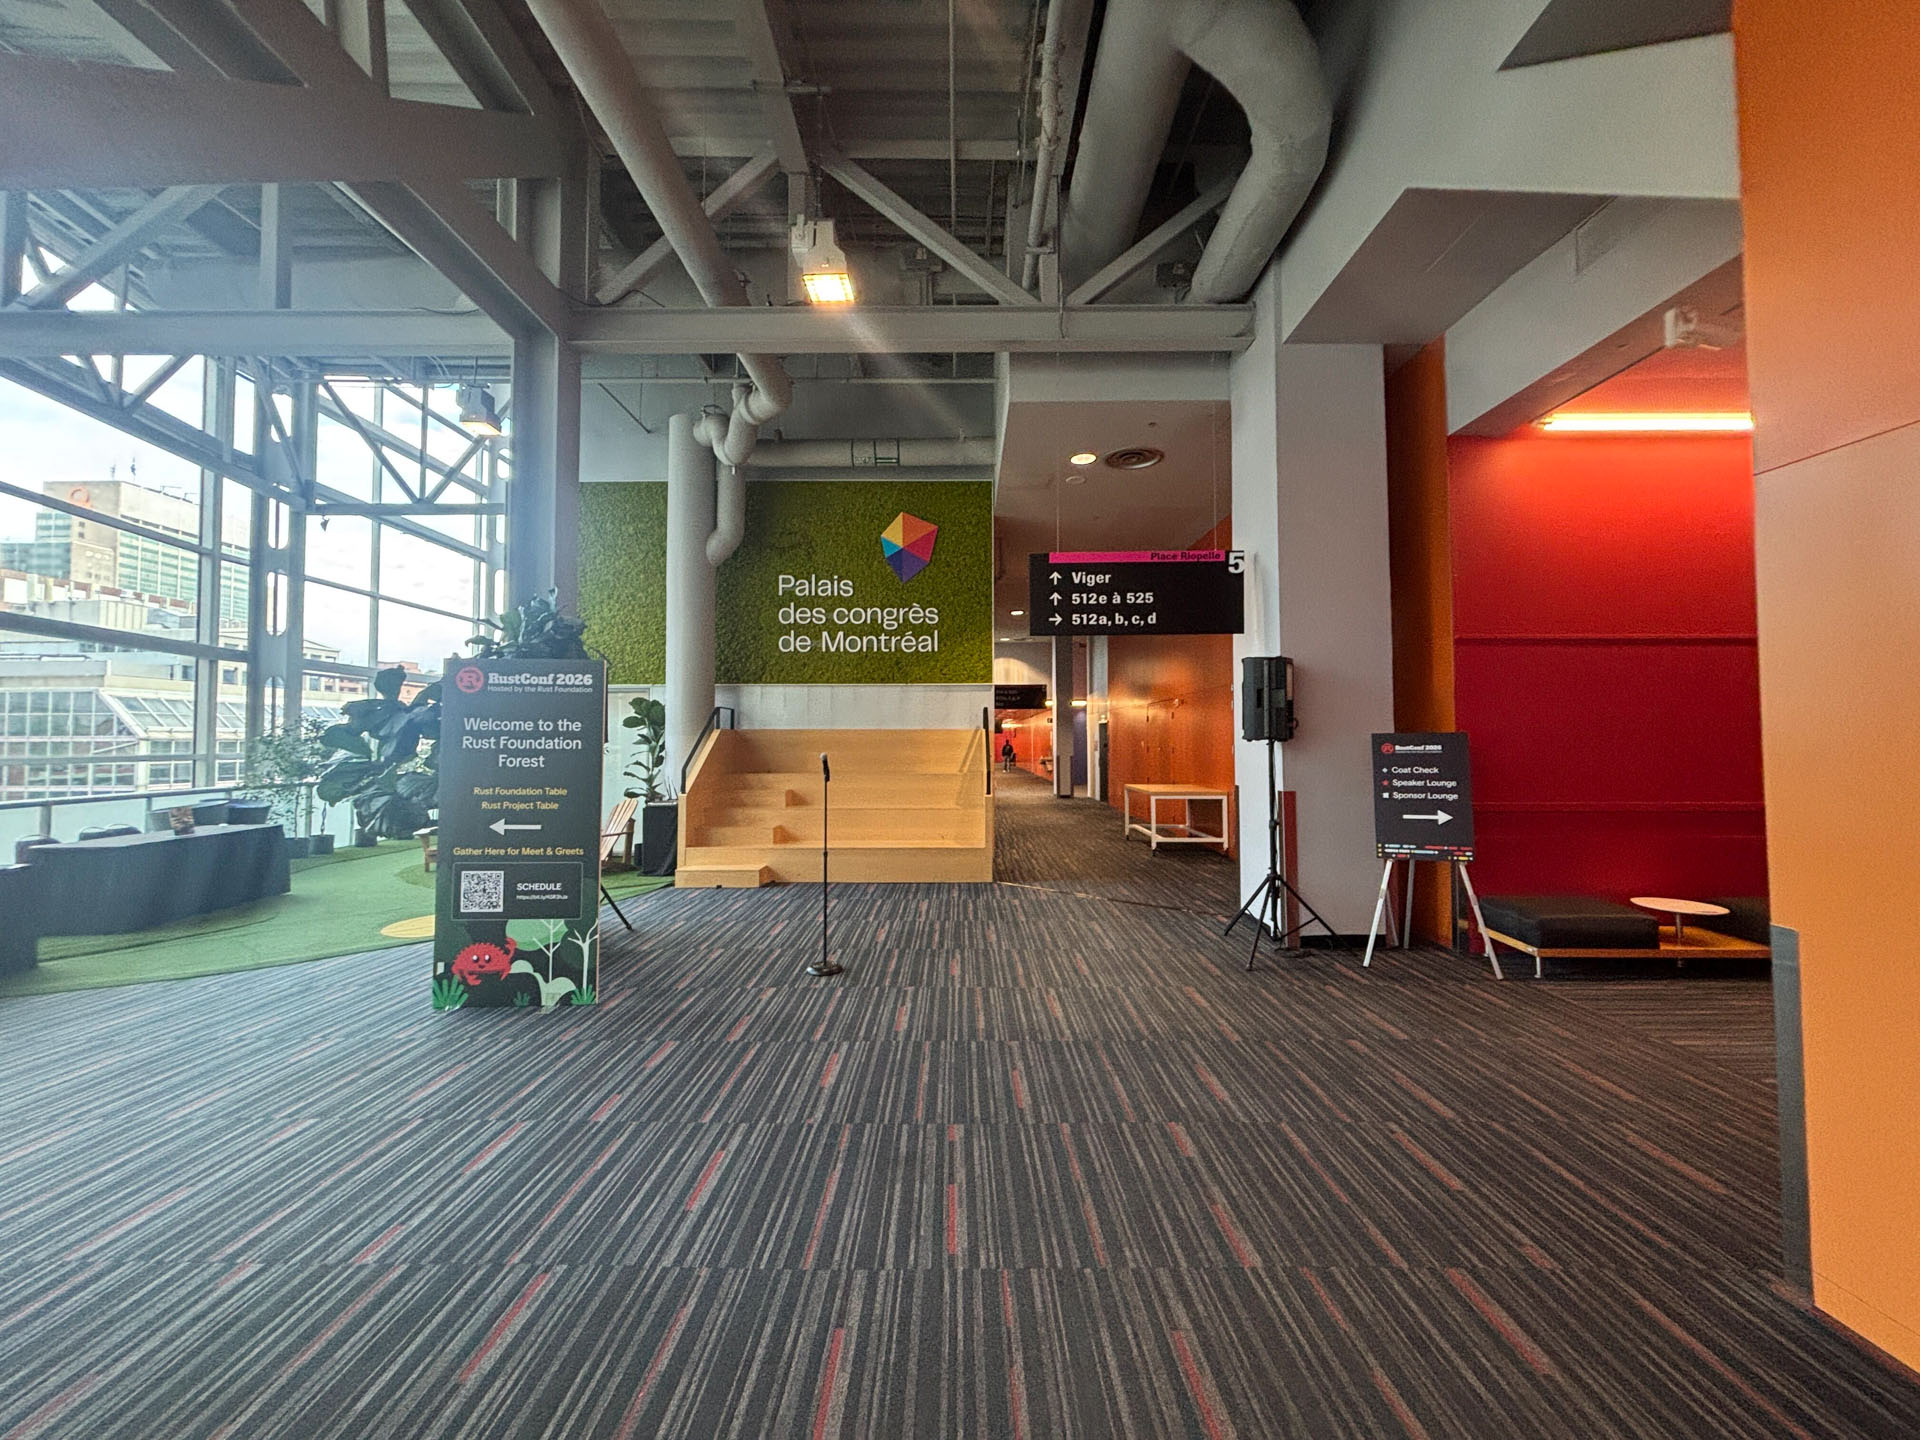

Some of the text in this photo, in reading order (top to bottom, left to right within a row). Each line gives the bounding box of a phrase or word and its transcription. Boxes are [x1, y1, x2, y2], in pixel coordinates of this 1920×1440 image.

[1151, 551, 1220, 562] Place Riopelle
[1228, 551, 1244, 574] 5
[778, 574, 854, 597] Palais
[1071, 571, 1111, 586] Viger
[1071, 591, 1154, 605] 512e à 525
[778, 602, 939, 630] des congrès
[1071, 612, 1157, 627] 512a, b, c, d
[778, 629, 939, 653] de Montréal
[488, 672, 593, 686] RustConf 2026
[464, 717, 582, 732] Welcome to the
[462, 736, 582, 750] Rust Foundation
[498, 754, 545, 768] Forest
[1391, 766, 1439, 774] Coat Check
[1392, 779, 1457, 788] Speaker Lounge
[473, 787, 568, 796] Rust Foundation Table
[1392, 791, 1459, 801] Sponsor Lounge
[481, 801, 559, 811] Rust Project Table
[453, 847, 584, 856] Gather Here for Meet & Greets
[516, 882, 562, 891] SCHEDULE
